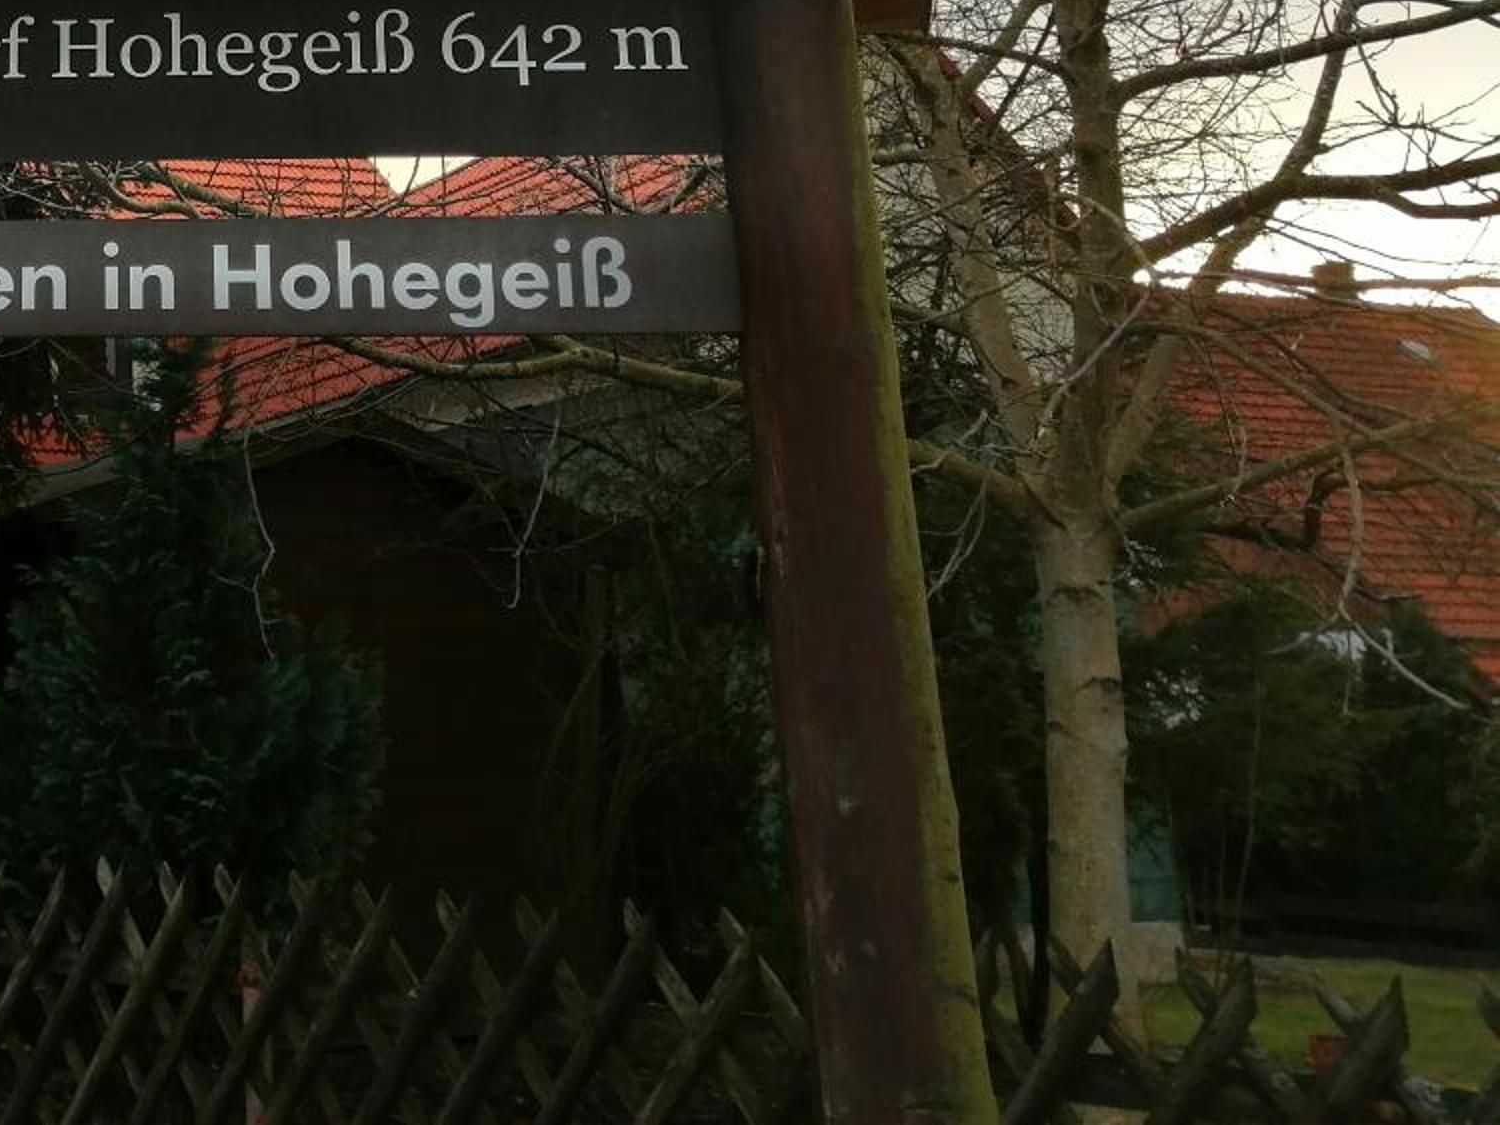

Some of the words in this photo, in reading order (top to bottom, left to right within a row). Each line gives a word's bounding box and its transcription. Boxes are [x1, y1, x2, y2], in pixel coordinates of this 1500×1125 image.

[51, 9, 414, 92] Hohegeiß
[441, 12, 586, 86] 642
[610, 26, 689, 70] m
[103, 241, 175, 310] in
[212, 236, 631, 328] Hohegeiß
